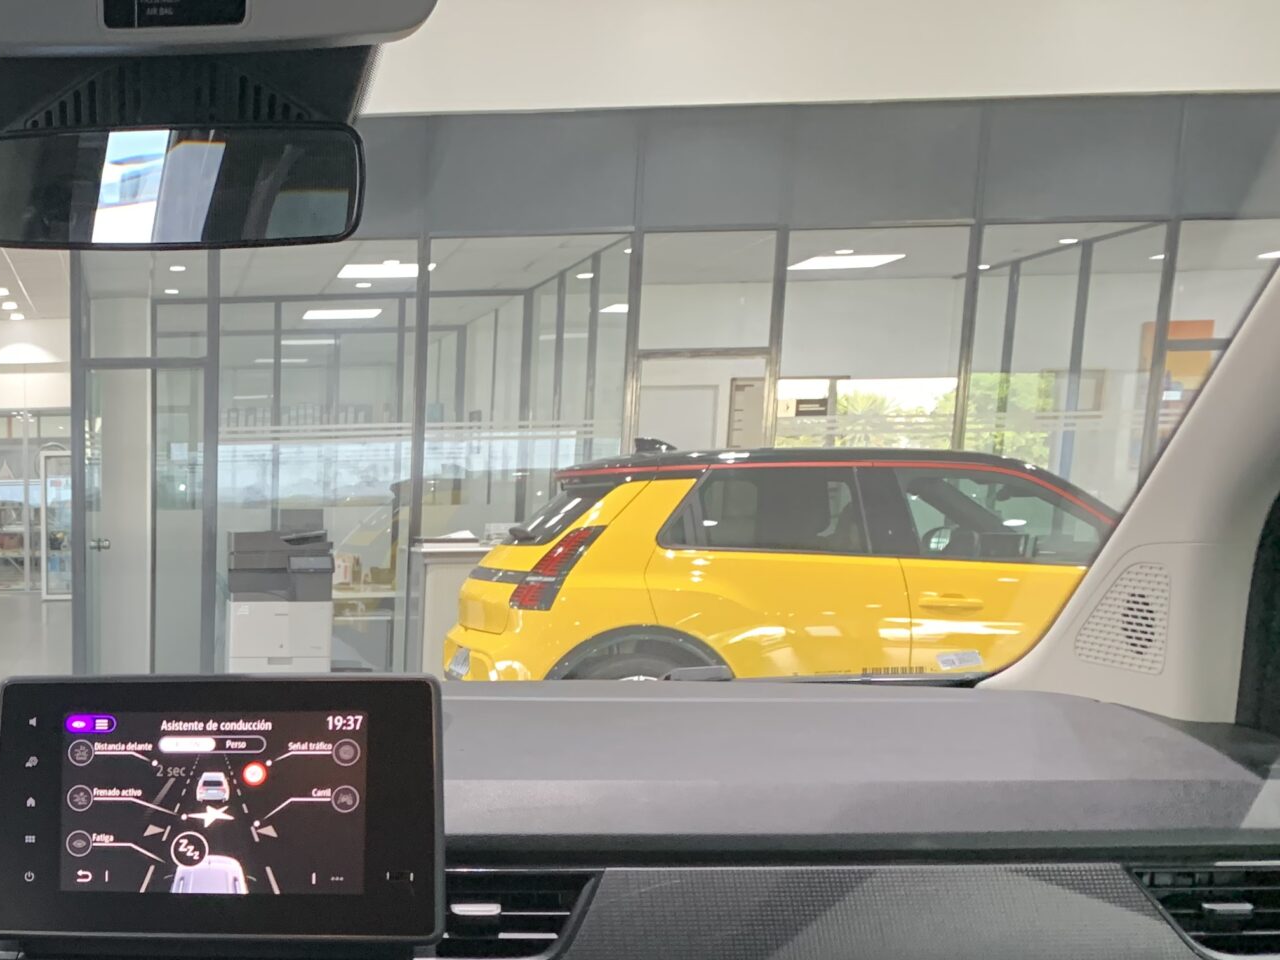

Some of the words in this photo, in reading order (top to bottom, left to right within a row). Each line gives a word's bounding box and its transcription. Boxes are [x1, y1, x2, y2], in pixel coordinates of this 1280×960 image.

[161, 719, 205, 731] Asistente
[206, 719, 218, 731] de
[220, 719, 272, 731] conducción
[327, 715, 363, 731] 19:37
[94, 742, 124, 751] Distancia
[125, 741, 153, 751] delante
[225, 740, 247, 749] Perso
[288, 741, 308, 750] Señal
[309, 741, 333, 750] tráfico
[156, 766, 164, 777] 2
[167, 767, 186, 777] sec
[93, 787, 120, 796] Frenado
[121, 787, 142, 796] activo
[92, 833, 114, 843] Fatiga
